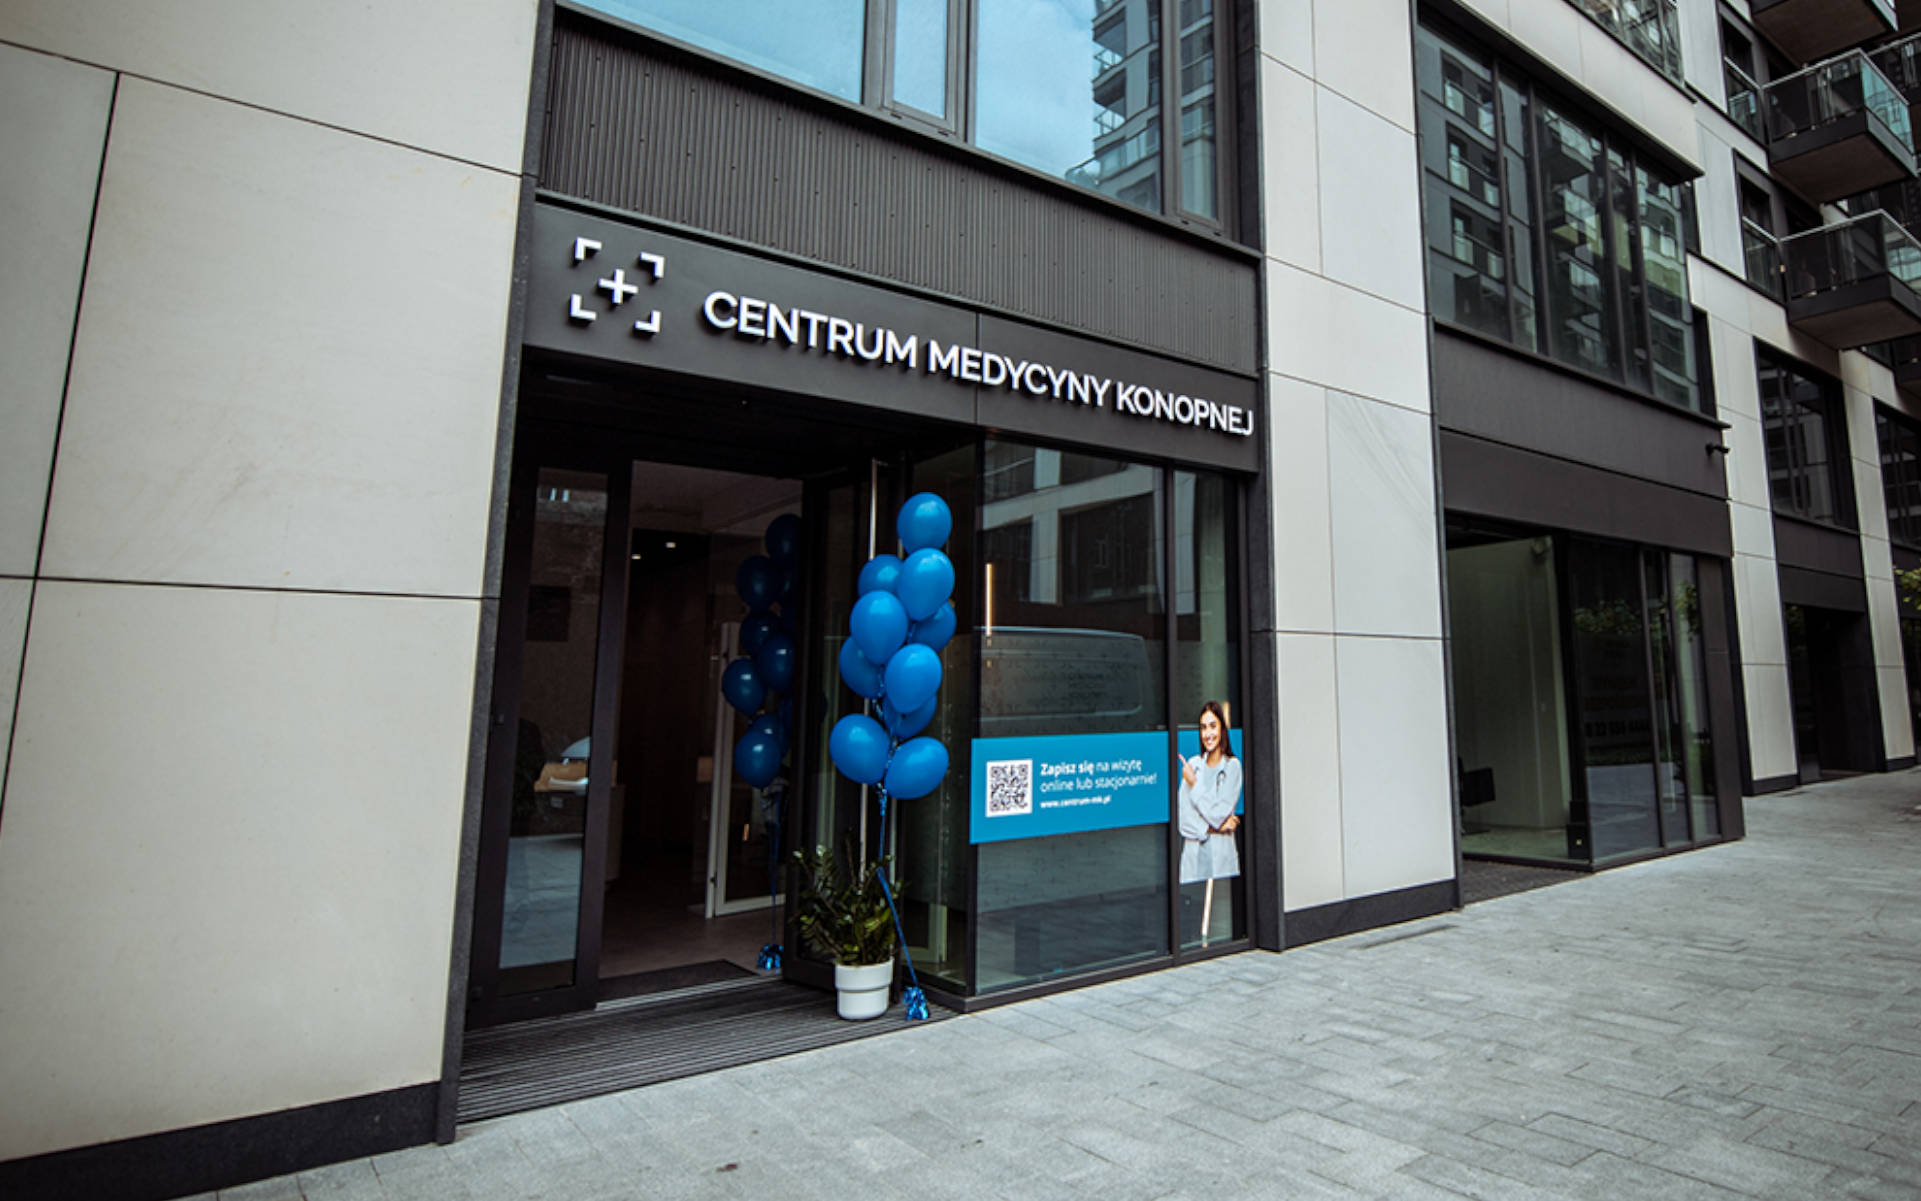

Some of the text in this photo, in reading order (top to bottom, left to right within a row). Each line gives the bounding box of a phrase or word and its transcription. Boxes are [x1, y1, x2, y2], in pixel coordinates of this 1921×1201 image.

[703, 290, 1255, 436] CENTRUM MEDYCYNY KONOPNEJ
[1040, 760, 1142, 778] Zapisz się na wizytę
[1040, 772, 1157, 792] online lub stacjonarnie!
